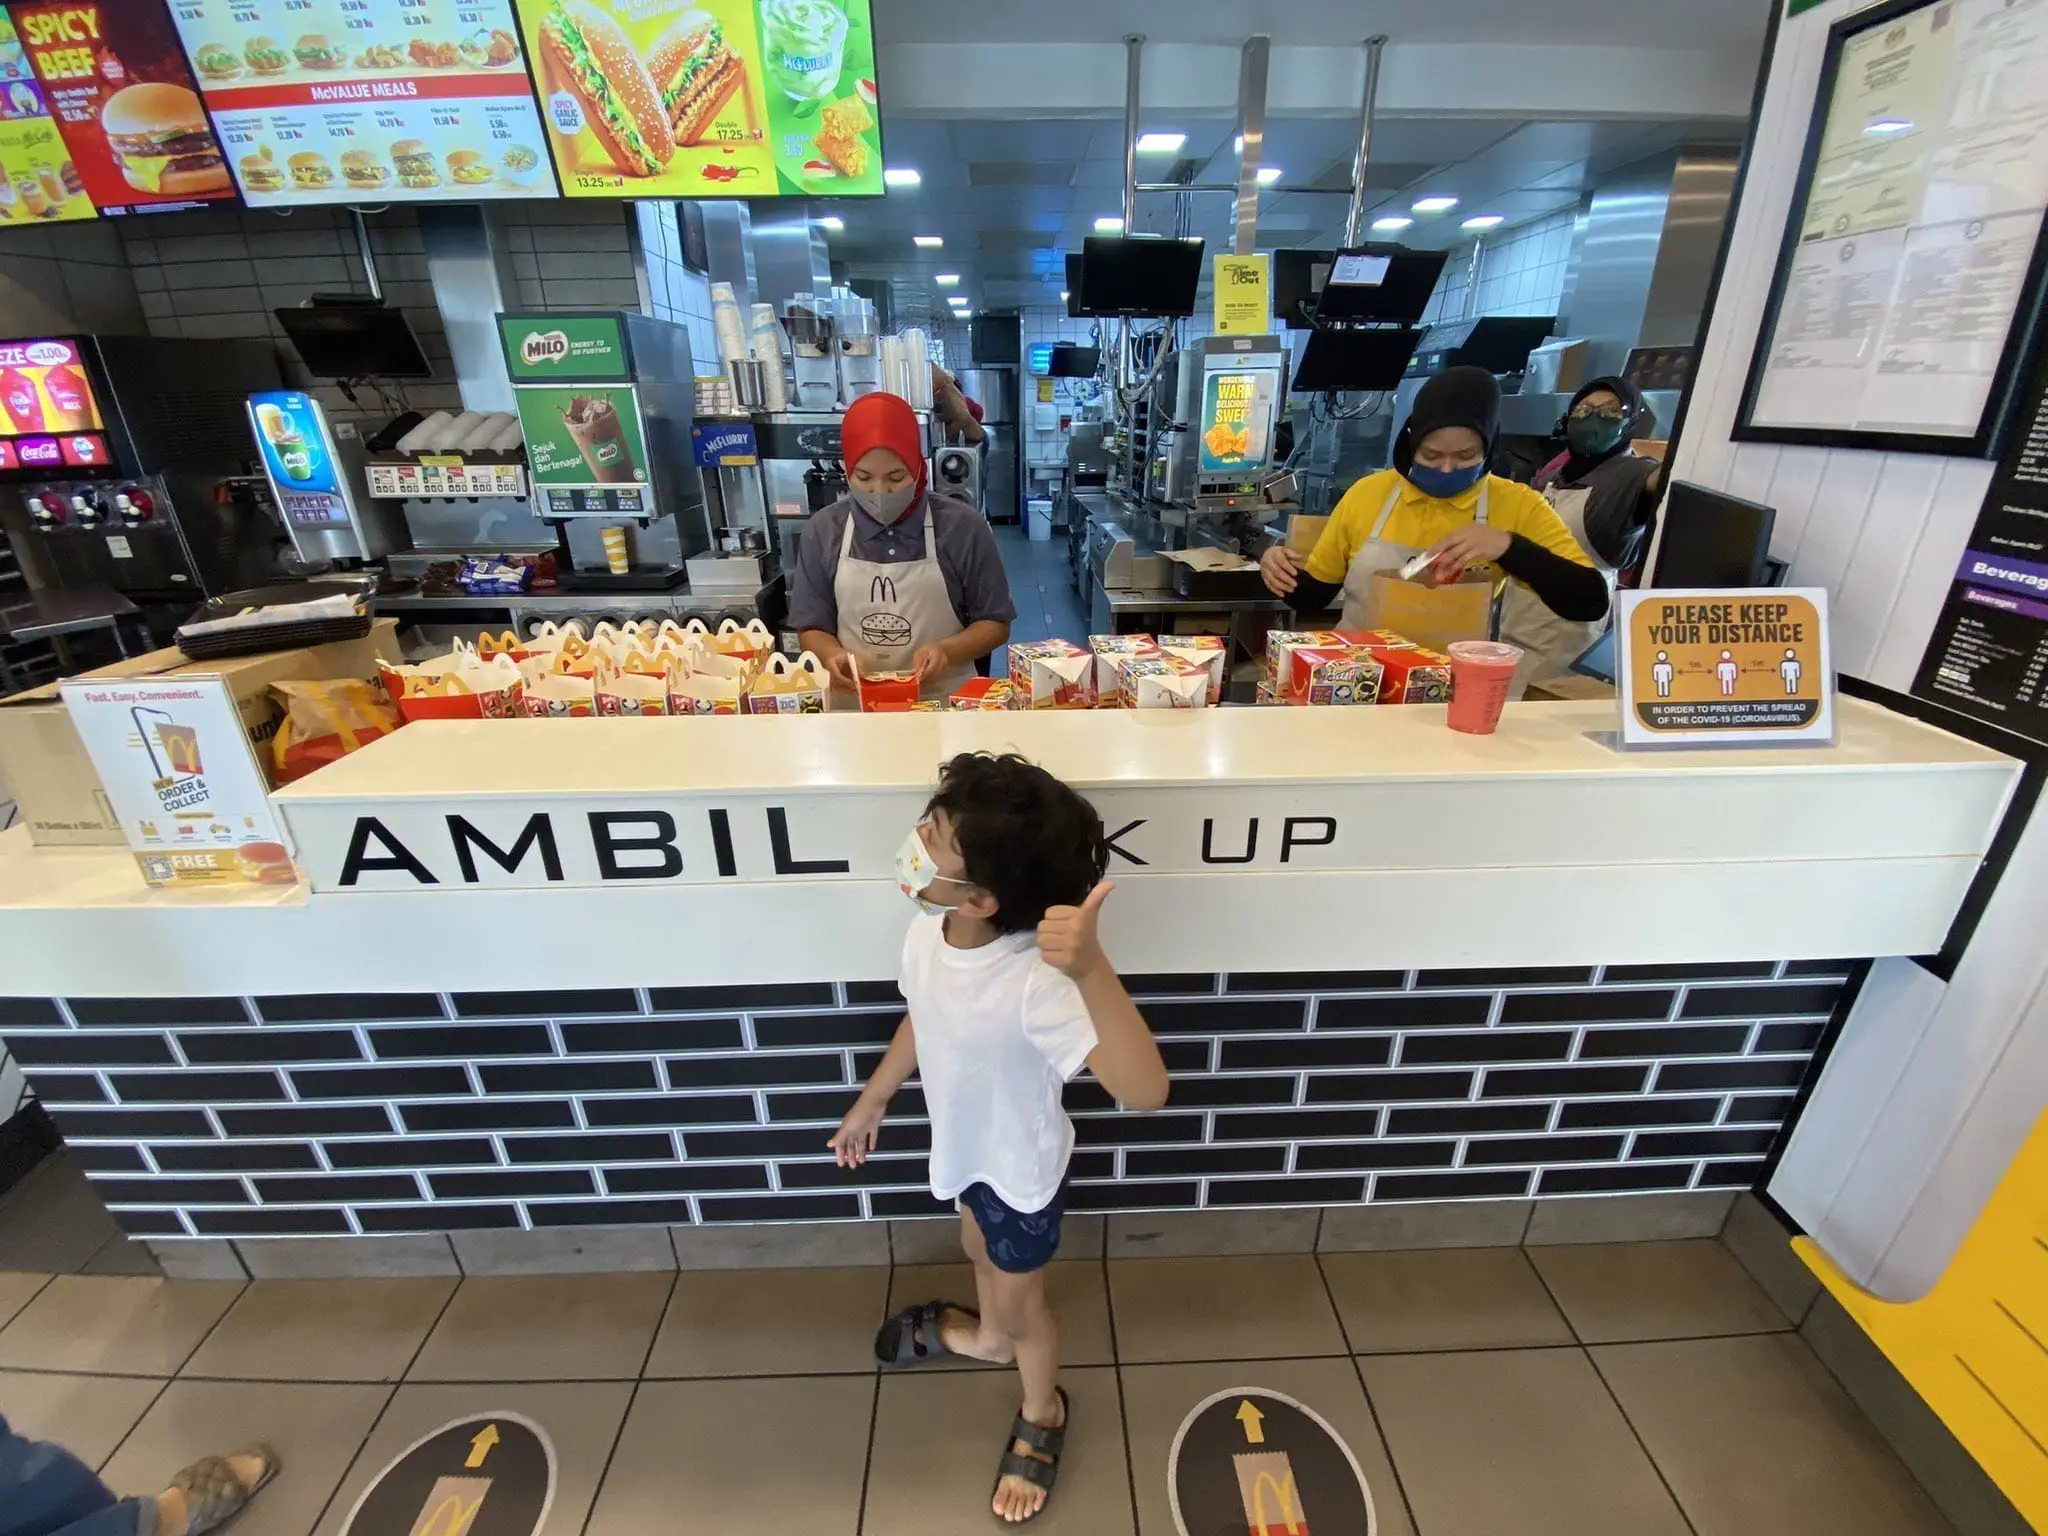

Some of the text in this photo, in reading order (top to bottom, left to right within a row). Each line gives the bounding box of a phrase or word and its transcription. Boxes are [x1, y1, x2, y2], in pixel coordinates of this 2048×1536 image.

[22, 9, 100, 45] SPICY
[35, 47, 96, 80] BEEF
[311, 82, 417, 100] McVALUE MEALS
[559, 118, 579, 126] SAUCE
[717, 129, 743, 140] 17.25
[577, 178, 604, 188] 13.25
[1240, 276, 1260, 284] Out
[527, 340, 565, 357] MILO
[532, 441, 556, 454] Sejuk
[600, 448, 617, 458] MILO
[534, 454, 551, 464] dan
[536, 455, 583, 472] Bertenaga!
[1972, 562, 2048, 590] Beverag
[1968, 590, 2018, 609] Beverages
[1662, 604, 1788, 624] PLEASE KEEP
[1648, 624, 1804, 644] YOUR DISTANCE
[84, 690, 204, 703] Fast. Easy. Convenient.
[780, 700, 796, 709] DC
[1652, 704, 1806, 714] IN ORDER TO PREVENT THE SPREAD
[1672, 716, 1690, 724] THE
[1691, 715, 1730, 724] COVID-19
[1732, 714, 1802, 724] (CORONAVIRUS).
[158, 778, 206, 801] ORDER &
[164, 790, 210, 812] COLLECT
[338, 806, 850, 886] AMBIL
[1201, 816, 1337, 864] UP
[172, 853, 218, 868] FREE
